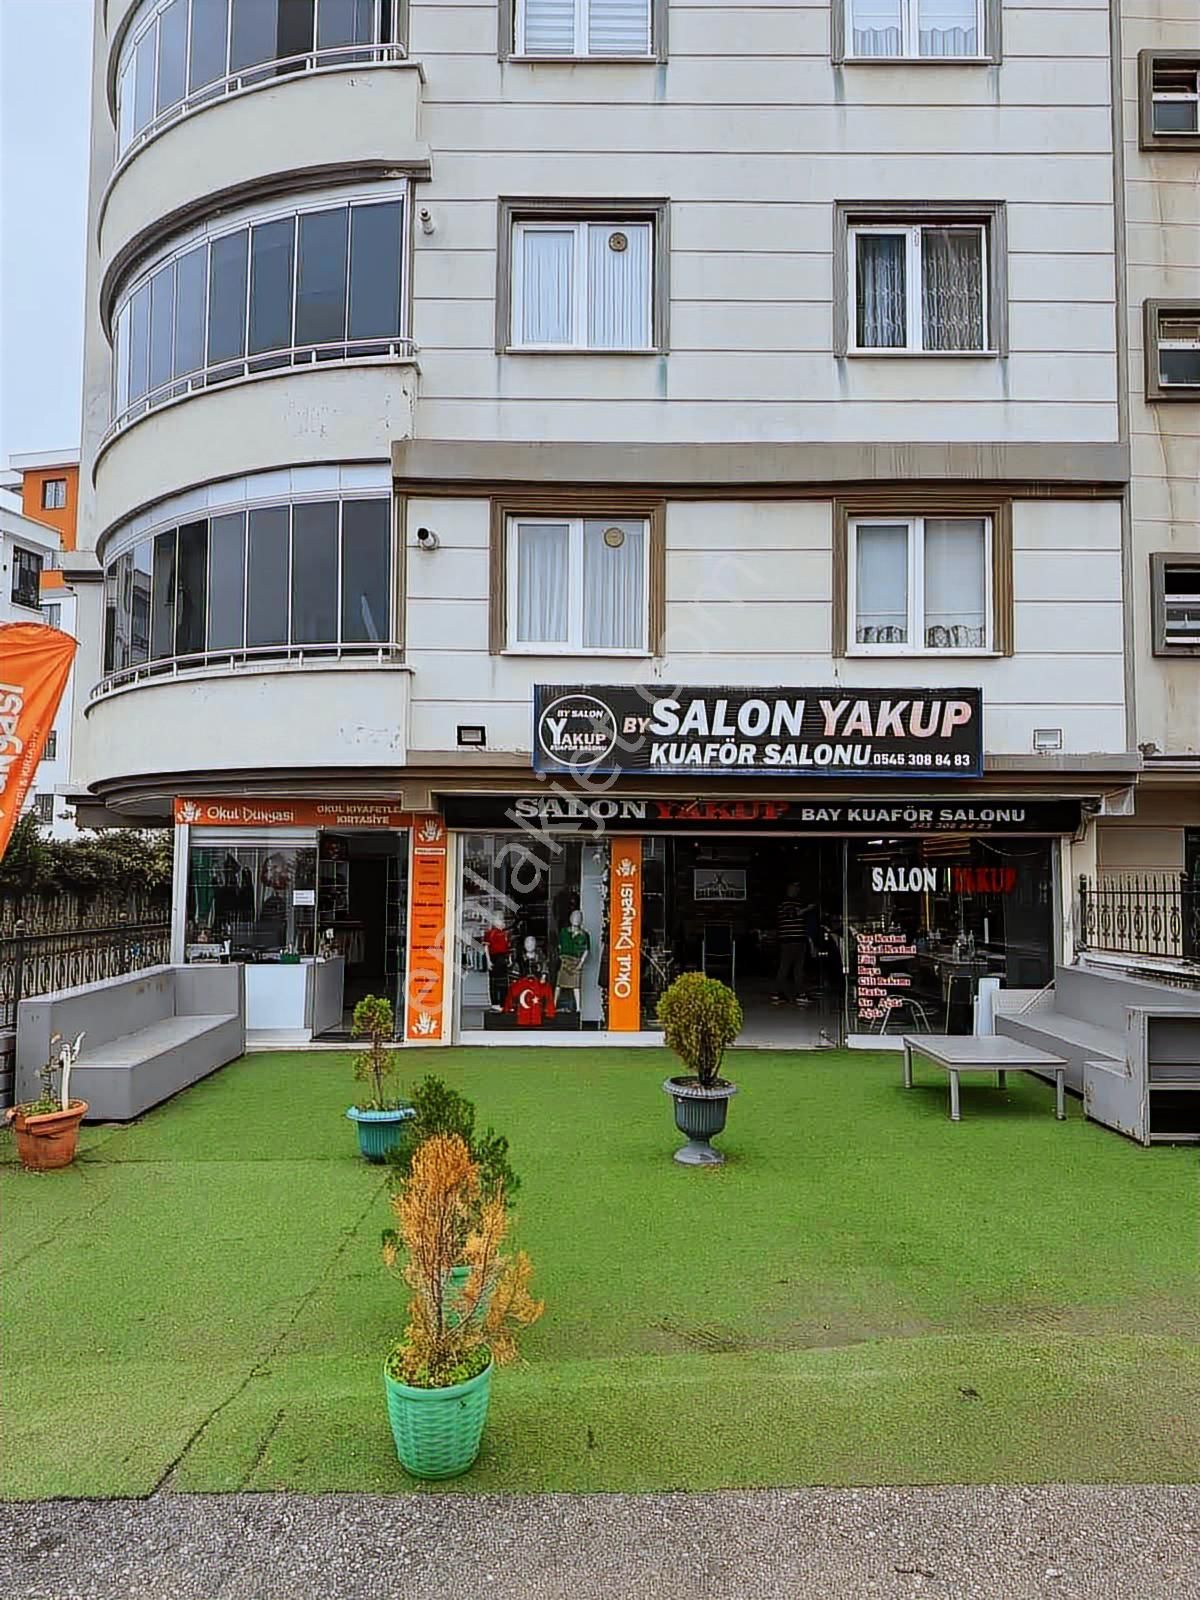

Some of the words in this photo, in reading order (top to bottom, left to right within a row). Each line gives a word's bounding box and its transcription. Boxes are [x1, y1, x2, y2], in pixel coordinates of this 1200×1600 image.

[557, 709, 571, 718] BY
[571, 709, 604, 718] SALON
[622, 717, 651, 734] BY
[649, 698, 806, 737] SALON
[819, 700, 973, 738] YAKUP
[546, 717, 606, 745] YAKUP
[650, 738, 757, 765] KUAFÖR
[763, 743, 872, 766] SALONU
[873, 753, 905, 765] 0545
[908, 754, 932, 766] 308
[935, 755, 951, 767] 84
[954, 755, 971, 767] 83
[514, 798, 649, 819] SALON
[653, 800, 791, 820] YAKUP
[801, 808, 843, 821] BAY
[847, 805, 933, 822] KUAFÖR
[939, 809, 1026, 822] SALONU
[871, 866, 938, 893] SALON
